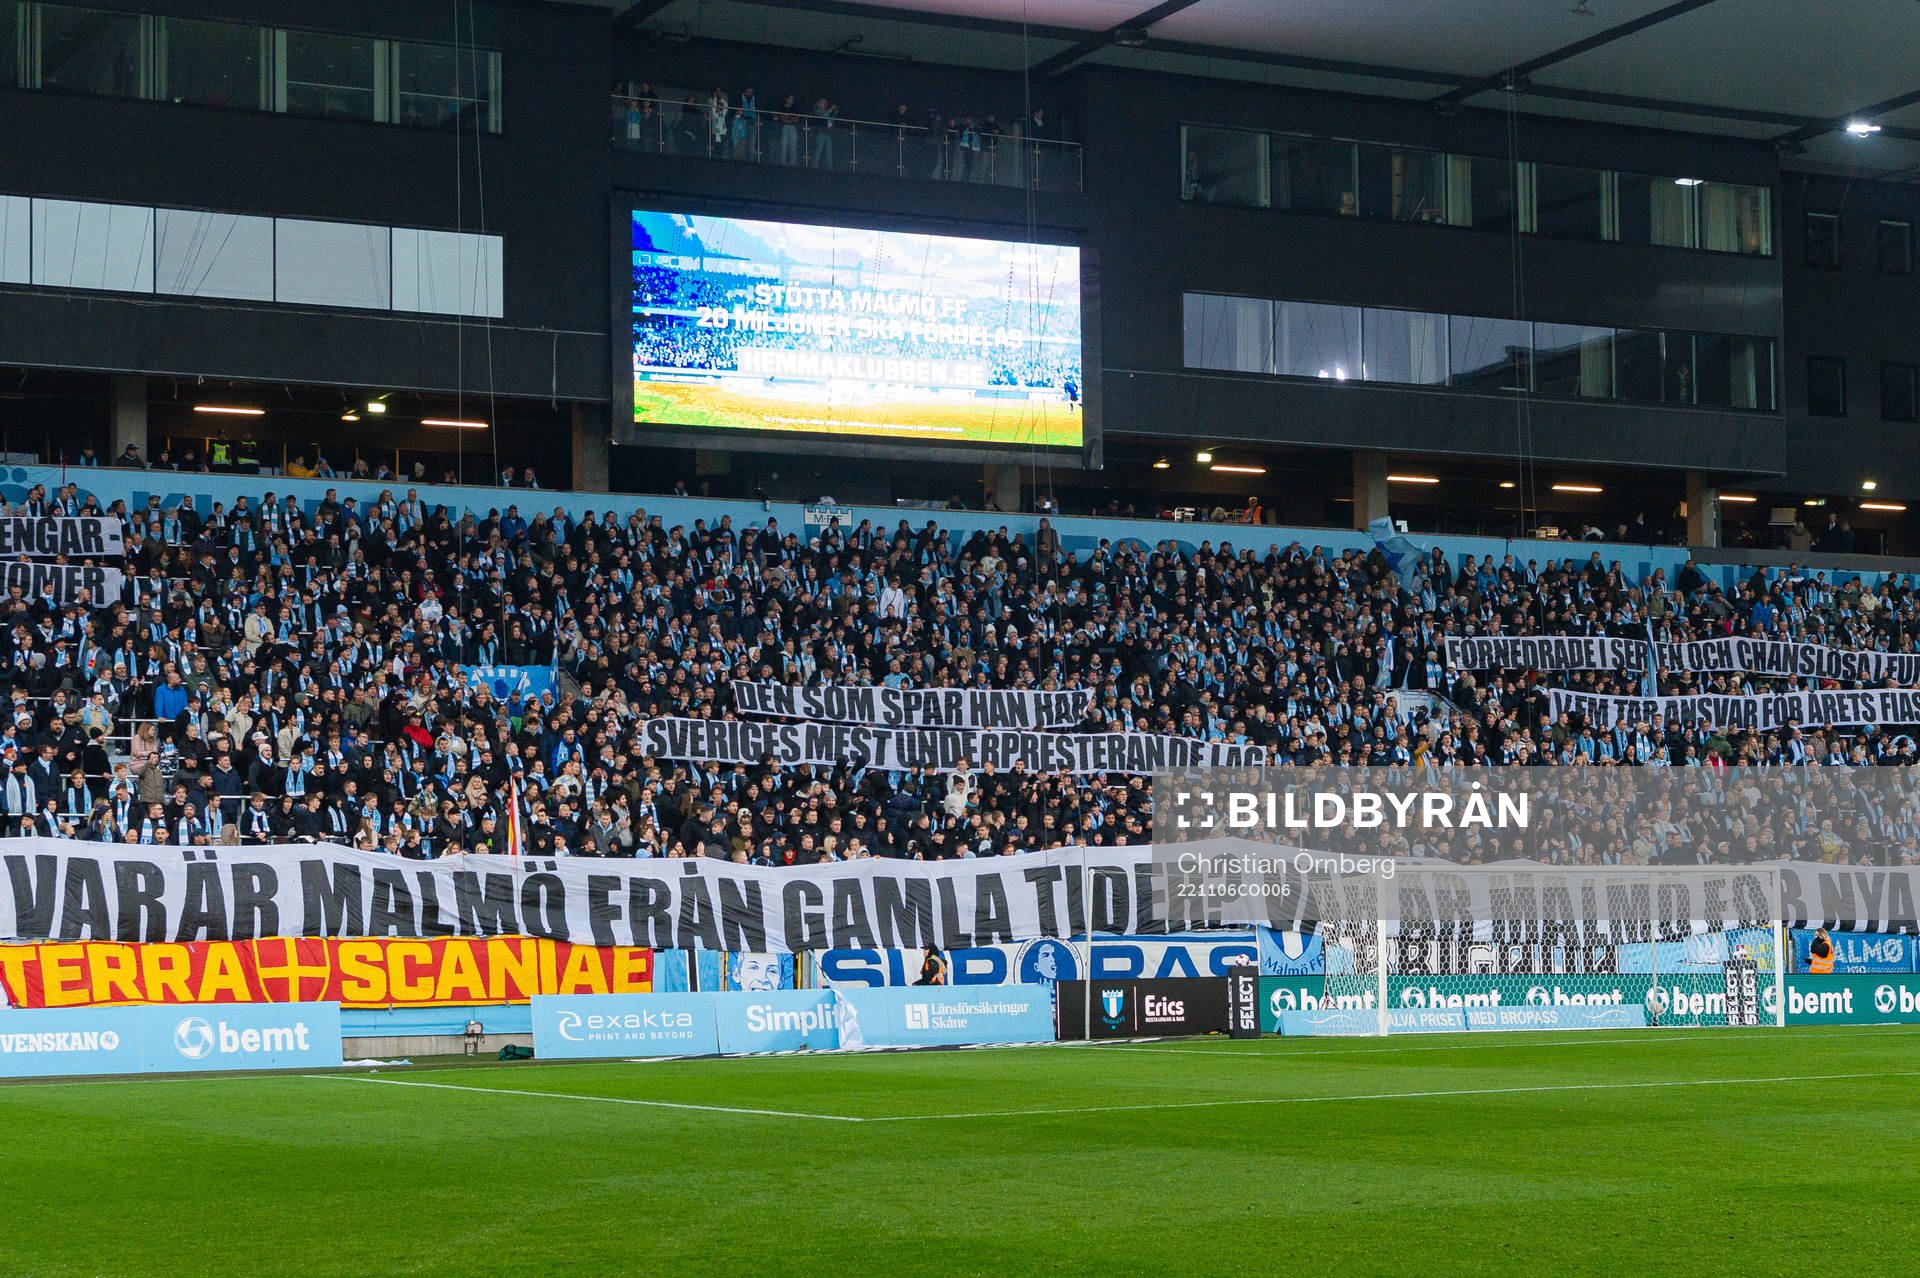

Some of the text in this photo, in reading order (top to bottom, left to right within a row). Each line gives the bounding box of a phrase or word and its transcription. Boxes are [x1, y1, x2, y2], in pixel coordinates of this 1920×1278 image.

[755, 281, 968, 318] STÖTTA MALMÖ FF
[696, 306, 1024, 348] 20 MILJONER SKA FÖRDELAS
[743, 350, 985, 386] HEMMAKLUBBEN.SE
[1690, 639, 1732, 671] OCH
[734, 681, 1088, 728] DEN SOM SPAR HAN HAR
[1553, 691, 1609, 729] VEM
[1613, 699, 1659, 728] TAR
[1665, 697, 1759, 730] ANSVAR
[1763, 693, 1804, 728] FÖR
[646, 719, 800, 764] SVERIGES
[805, 724, 892, 767] MEST
[4, 855, 167, 942] VAR
[175, 850, 279, 942] ÄR
[300, 860, 570, 941] MALMÖ
[588, 862, 766, 953] FRÅN
[782, 872, 1014, 951] GAMLA
[1818, 871, 1919, 936] NYA
[1265, 953, 1326, 975] Malmö FF
[1809, 938, 1904, 964] ALMØ
[0, 939, 652, 1007] TERRA SCANIAE
[931, 1001, 1029, 1016] Länsförsäkringar
[1145, 994, 1184, 1016] Erics
[1239, 975, 1254, 1030] SELECT
[1429, 986, 1501, 1008] bemt
[1673, 985, 1727, 1015] bem
[1789, 985, 1853, 1014] bemt
[587, 1009, 693, 1029] exakta
[746, 1003, 838, 1037] Simpli
[932, 1015, 968, 1029] Skåne
[1387, 1013, 1417, 1028] ALVA
[1420, 1012, 1462, 1027] PRISET
[1469, 1011, 1497, 1026] MED
[220, 1021, 309, 1053] bemt
[588, 1031, 694, 1041] PRINT AND BEYOND
